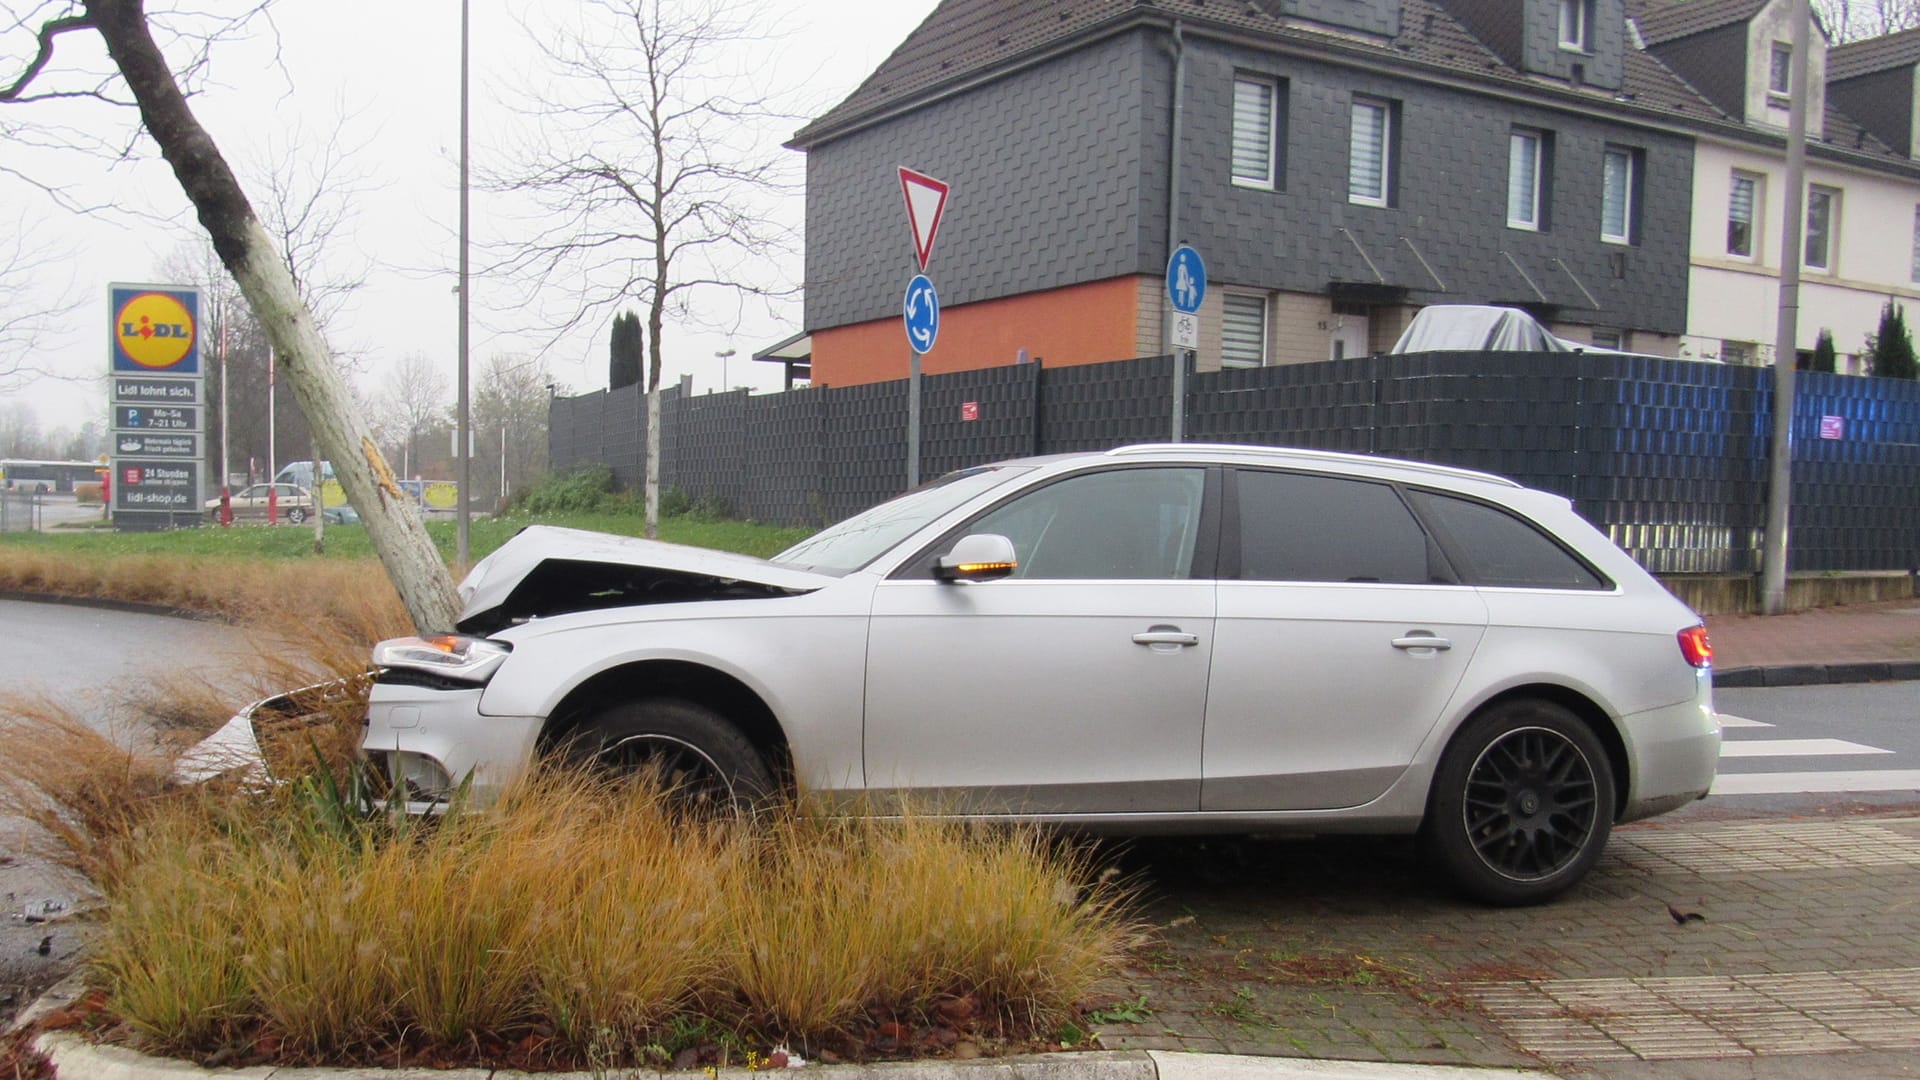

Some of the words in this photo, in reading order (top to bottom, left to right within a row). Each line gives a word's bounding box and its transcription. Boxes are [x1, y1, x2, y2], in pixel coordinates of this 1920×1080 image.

[118, 385, 138, 395] Lidl
[140, 385, 167, 396] lohnt
[169, 386, 194, 397] sich.
[171, 419, 188, 428] Uhr
[144, 468, 155, 478] 24
[156, 468, 189, 478] Stunden
[127, 492, 188, 505] lidl-shop.de
